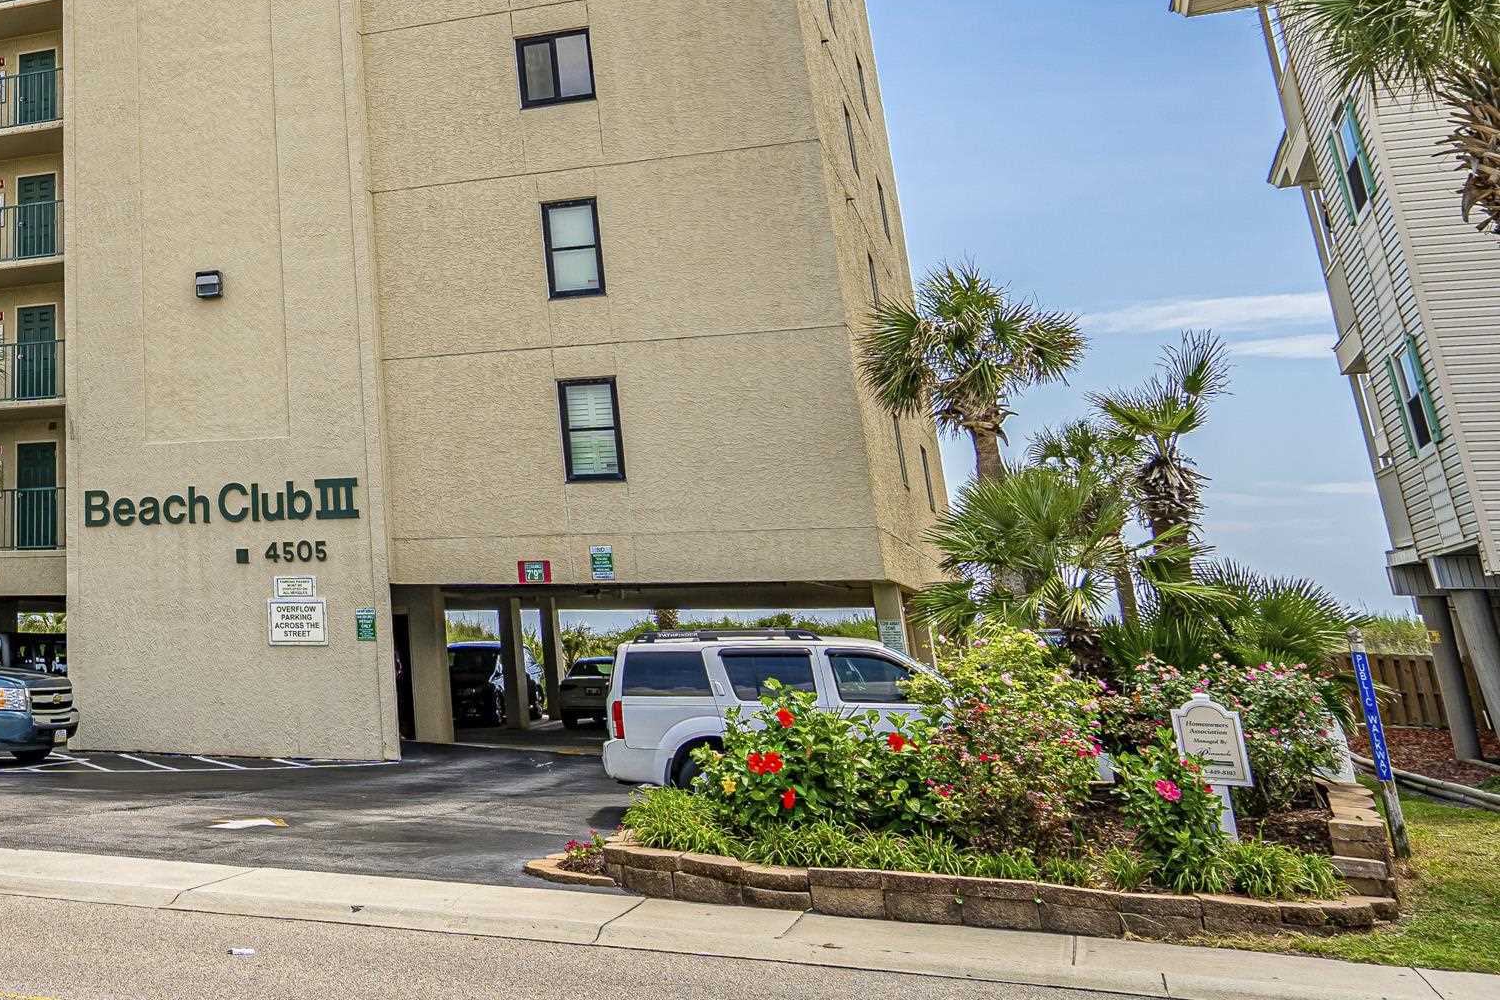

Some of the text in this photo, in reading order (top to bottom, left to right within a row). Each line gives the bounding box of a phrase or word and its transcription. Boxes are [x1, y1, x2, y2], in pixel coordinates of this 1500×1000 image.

[84, 477, 360, 527] Beach Club III
[264, 540, 328, 563] 4505
[1185, 720, 1229, 728] Homeowners
[1355, 654, 1388, 776] PUBLIC WALKWAY
